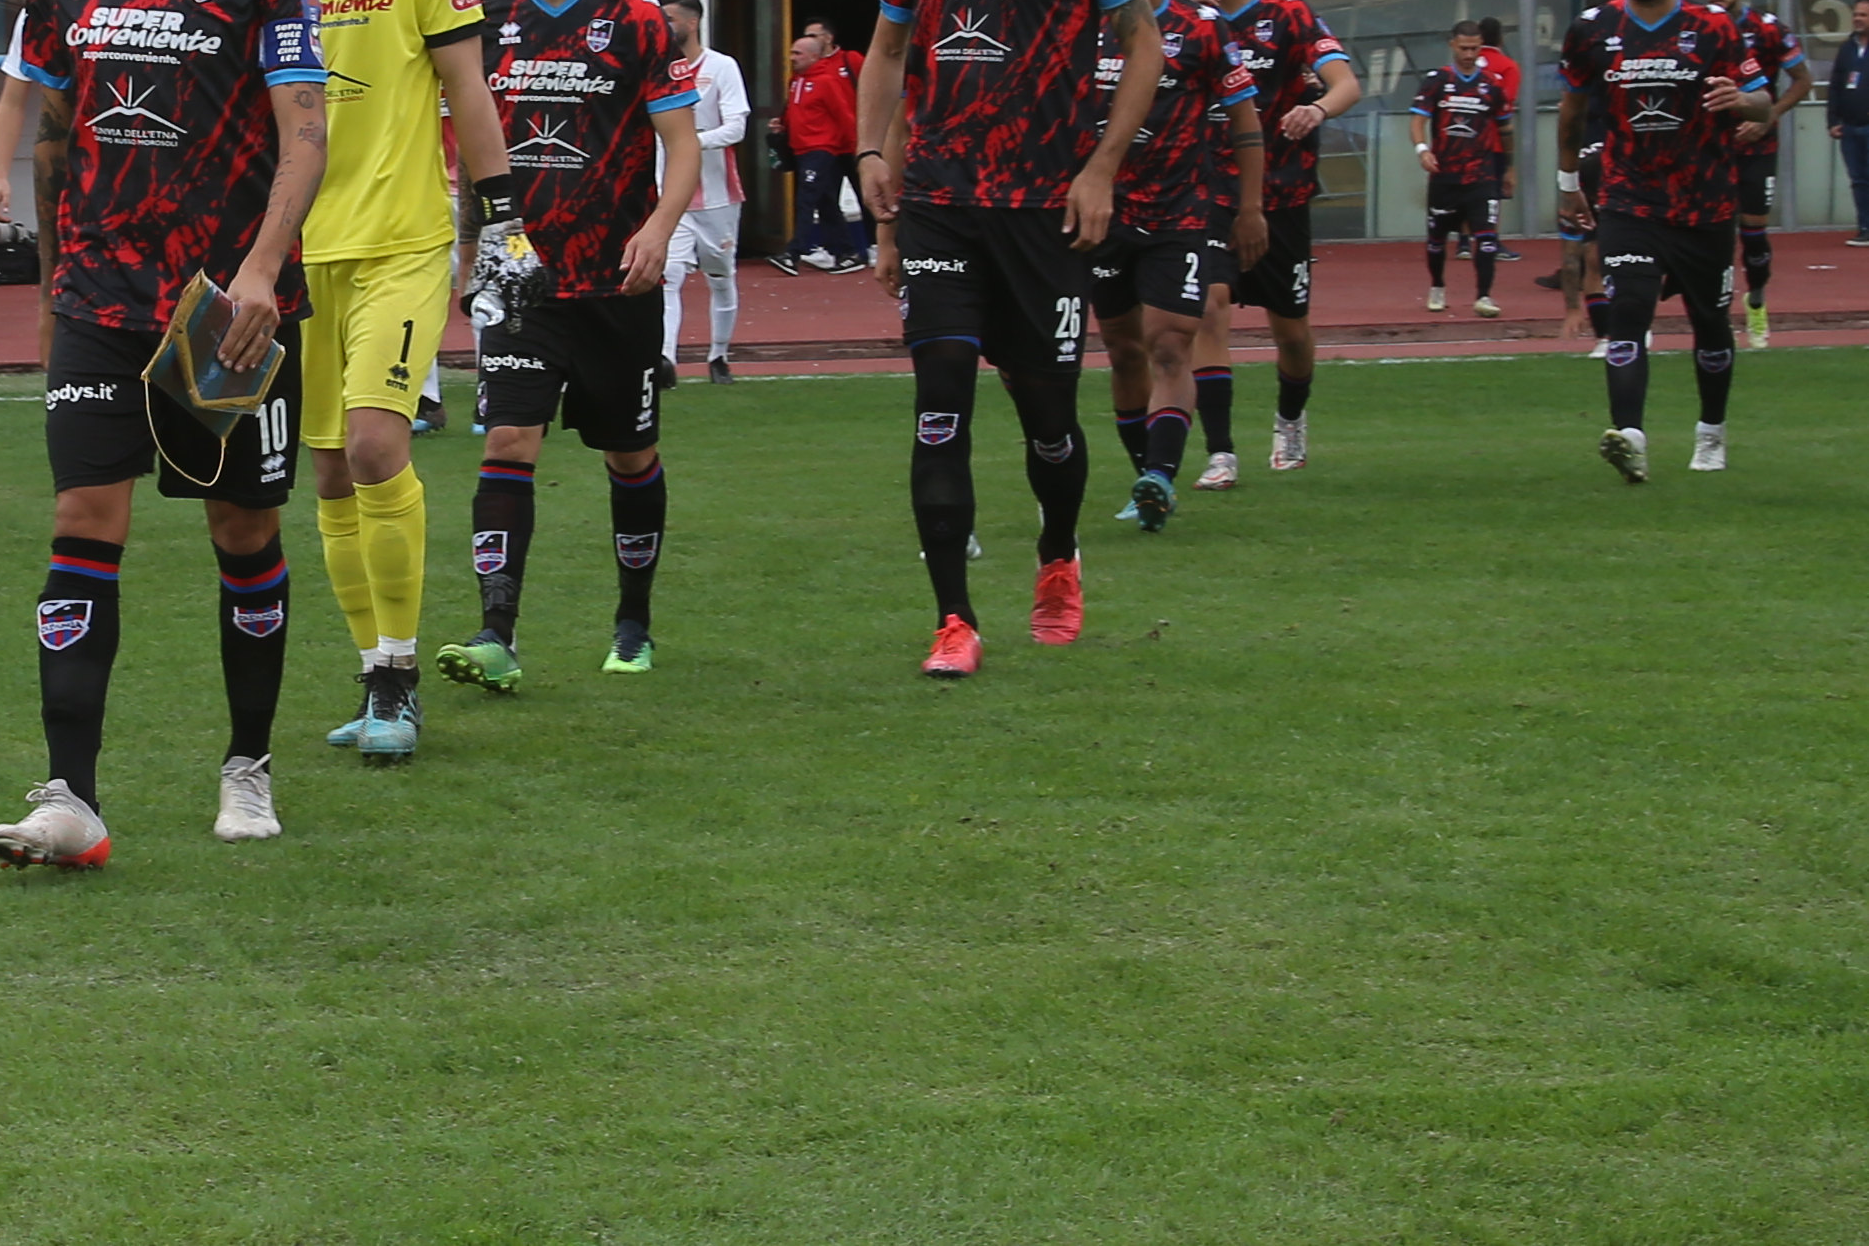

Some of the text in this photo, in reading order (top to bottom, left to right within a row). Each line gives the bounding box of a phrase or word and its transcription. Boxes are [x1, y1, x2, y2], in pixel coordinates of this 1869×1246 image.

[90, 7, 186, 31] SUPER
[65, 22, 223, 55] Conveniente
[509, 60, 588, 79] SUPER
[1620, 58, 1679, 71] SUPER
[488, 70, 616, 95] Conveniente
[124, 128, 179, 140] DELL'ETNA
[902, 257, 966, 276] foodys.it
[1185, 252, 1200, 284] 2
[1054, 296, 1082, 339] 26
[400, 320, 413, 364] 1
[641, 367, 654, 408] 5
[256, 398, 288, 455] 10
